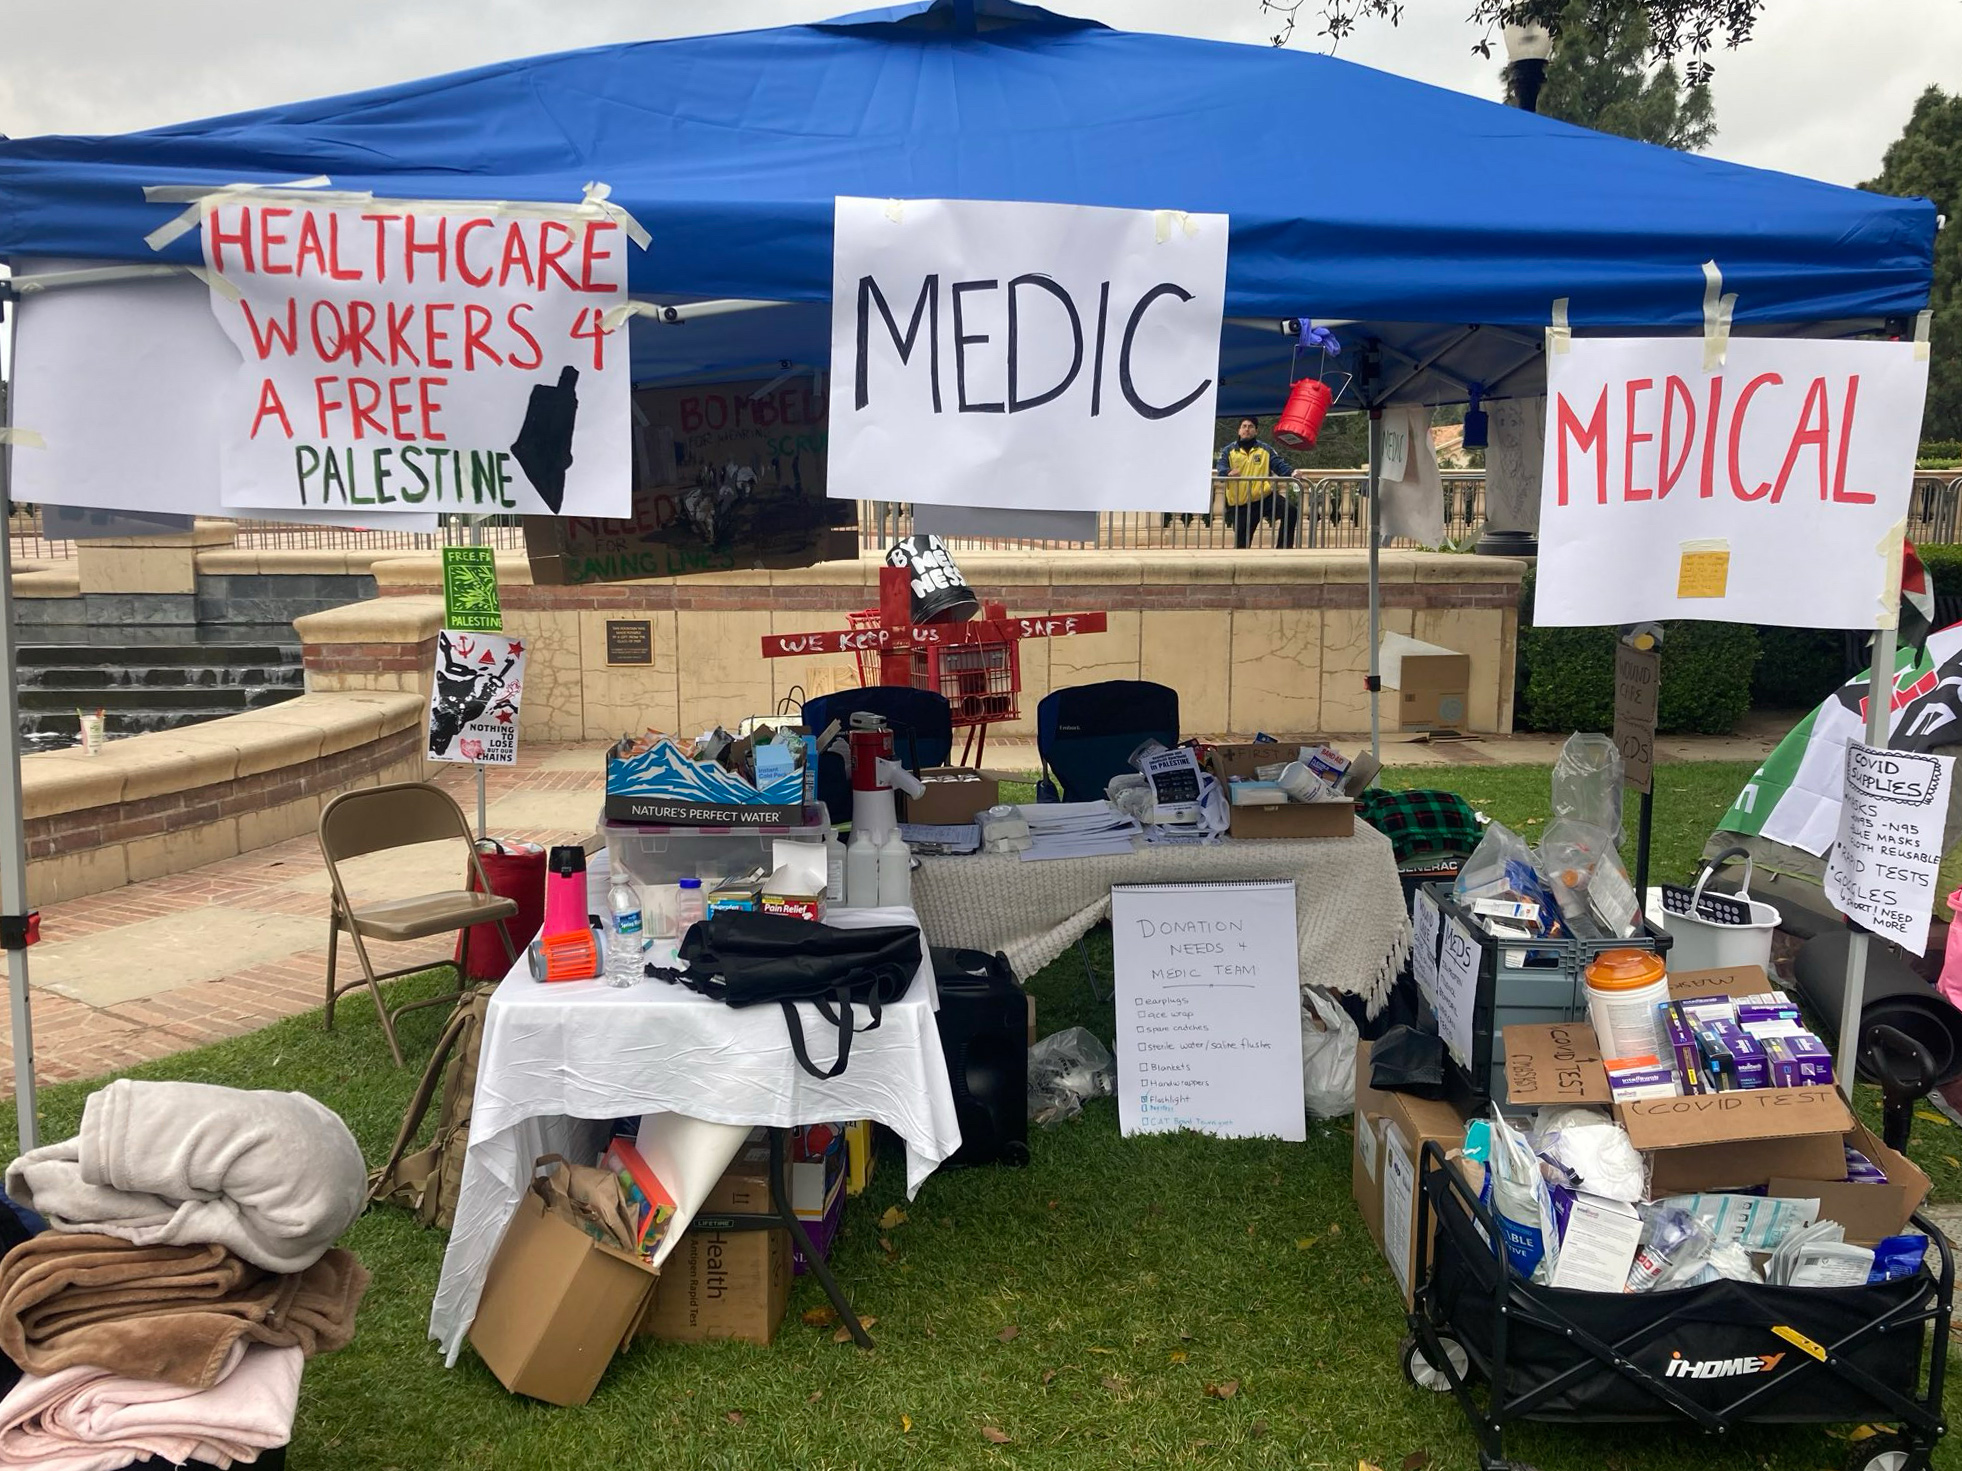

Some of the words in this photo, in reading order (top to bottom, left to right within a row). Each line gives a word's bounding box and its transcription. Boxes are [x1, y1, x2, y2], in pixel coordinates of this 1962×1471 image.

[210, 206, 618, 293] HEALTHCARE
[241, 297, 544, 371] WORKERS
[570, 307, 615, 371] 4
[855, 272, 1212, 421] MEDIC
[250, 377, 294, 441] A
[315, 376, 449, 442] FREE
[681, 388, 828, 433] BOMBED
[1557, 372, 1877, 507] MEDICAL
[298, 446, 517, 507] PALESTINE
[596, 538, 629, 552] FOR
[890, 535, 919, 568] BY
[566, 551, 658, 582] SAVING
[452, 615, 503, 628] PALESTINE
[780, 634, 824, 654] WE
[469, 723, 515, 734] NOTHING
[502, 733, 514, 741] TO
[490, 740, 514, 748] LOSE
[476, 753, 513, 762] CHAINS
[1158, 757, 1191, 770] PALESTINE
[1855, 752, 1900, 775] COVID
[1850, 767, 1922, 798] SUPPLIES
[630, 804, 688, 819] NATURE'S
[689, 807, 739, 822] PERFECT
[1877, 833, 1921, 848] MASKS
[1880, 845, 1941, 866] REUSABLE
[1875, 863, 1930, 887] TESTS
[1833, 870, 1898, 906] GOGGLES
[764, 903, 782, 913] Pain
[783, 904, 807, 914] Relief
[1881, 908, 1914, 924] NEED
[1136, 918, 1244, 939] DONATION
[1873, 917, 1908, 934] MORE
[1170, 942, 1225, 956] NEEDS
[1152, 967, 1202, 980] MEDIC
[1214, 964, 1256, 976] TEAM
[1145, 996, 1190, 1007] earplugs
[1147, 1011, 1168, 1019] ace
[1171, 1011, 1195, 1020] wrap
[1550, 1029, 1576, 1061] COVID
[1150, 1063, 1191, 1072] Blankets
[1150, 1079, 1210, 1088] Handwrappers
[1149, 1095, 1190, 1105] Flashlight
[1648, 1097, 1743, 1116] COVID
[1755, 1090, 1832, 1108] TEST
[688, 1240, 699, 1278] Antigen
[687, 1279, 699, 1307] Rapid
[689, 1308, 699, 1327] Test
